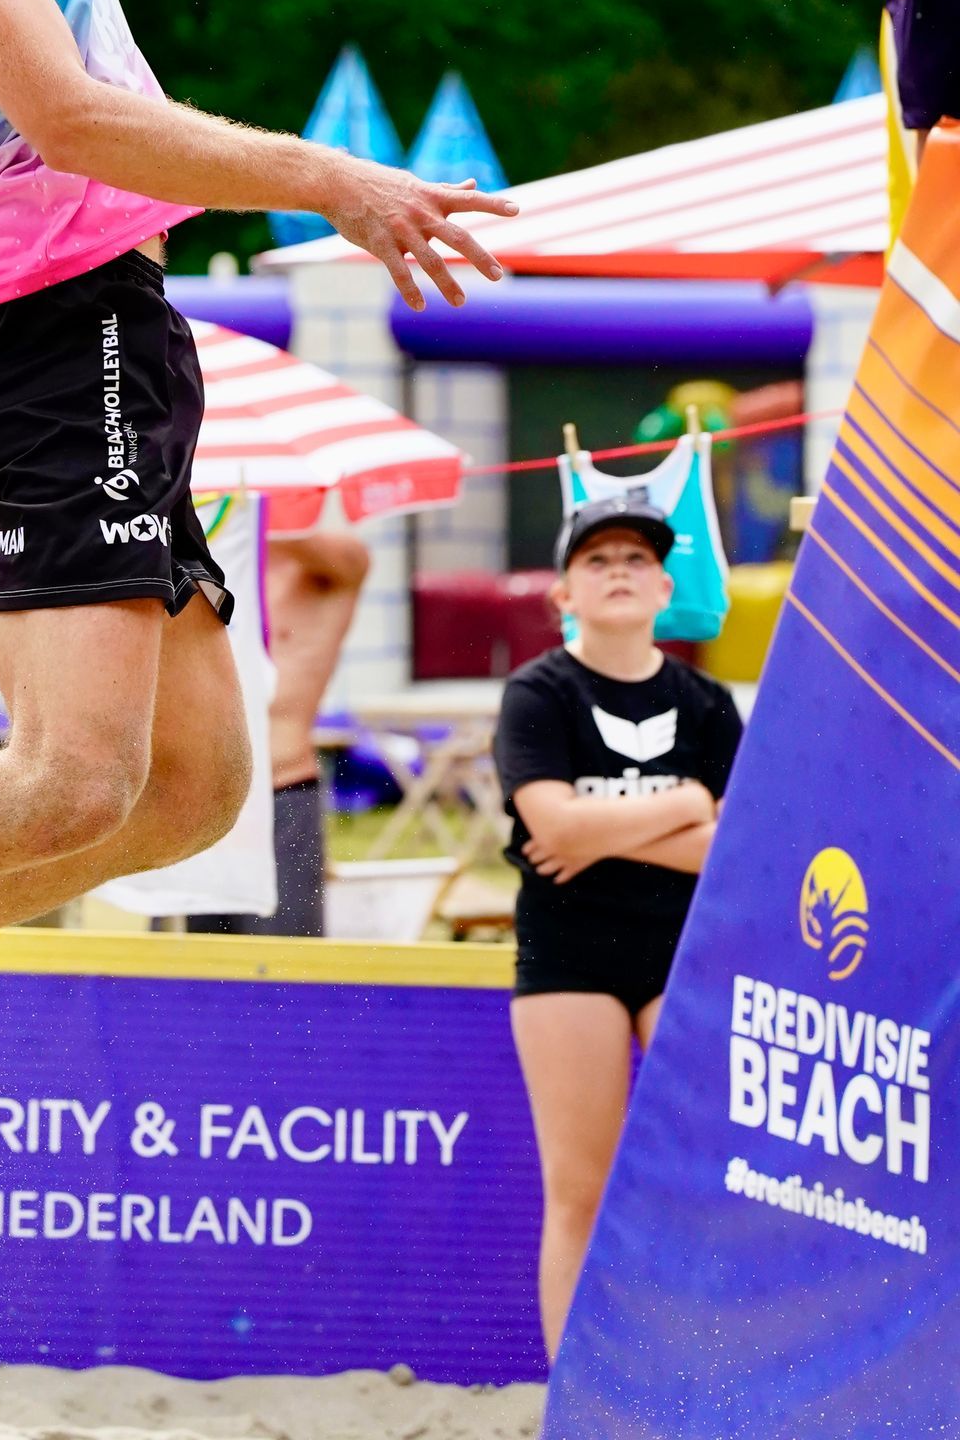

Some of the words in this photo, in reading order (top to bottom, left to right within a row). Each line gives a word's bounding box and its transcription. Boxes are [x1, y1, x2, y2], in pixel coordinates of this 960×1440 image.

[99, 514, 172, 547] WOV
[730, 974, 931, 1092] EREDIVISIE
[130, 1101, 179, 1158] &
[199, 1102, 470, 1167] FACILITY
[729, 1034, 930, 1184] BEACH
[724, 1156, 928, 1256] #eredivisiebeach
